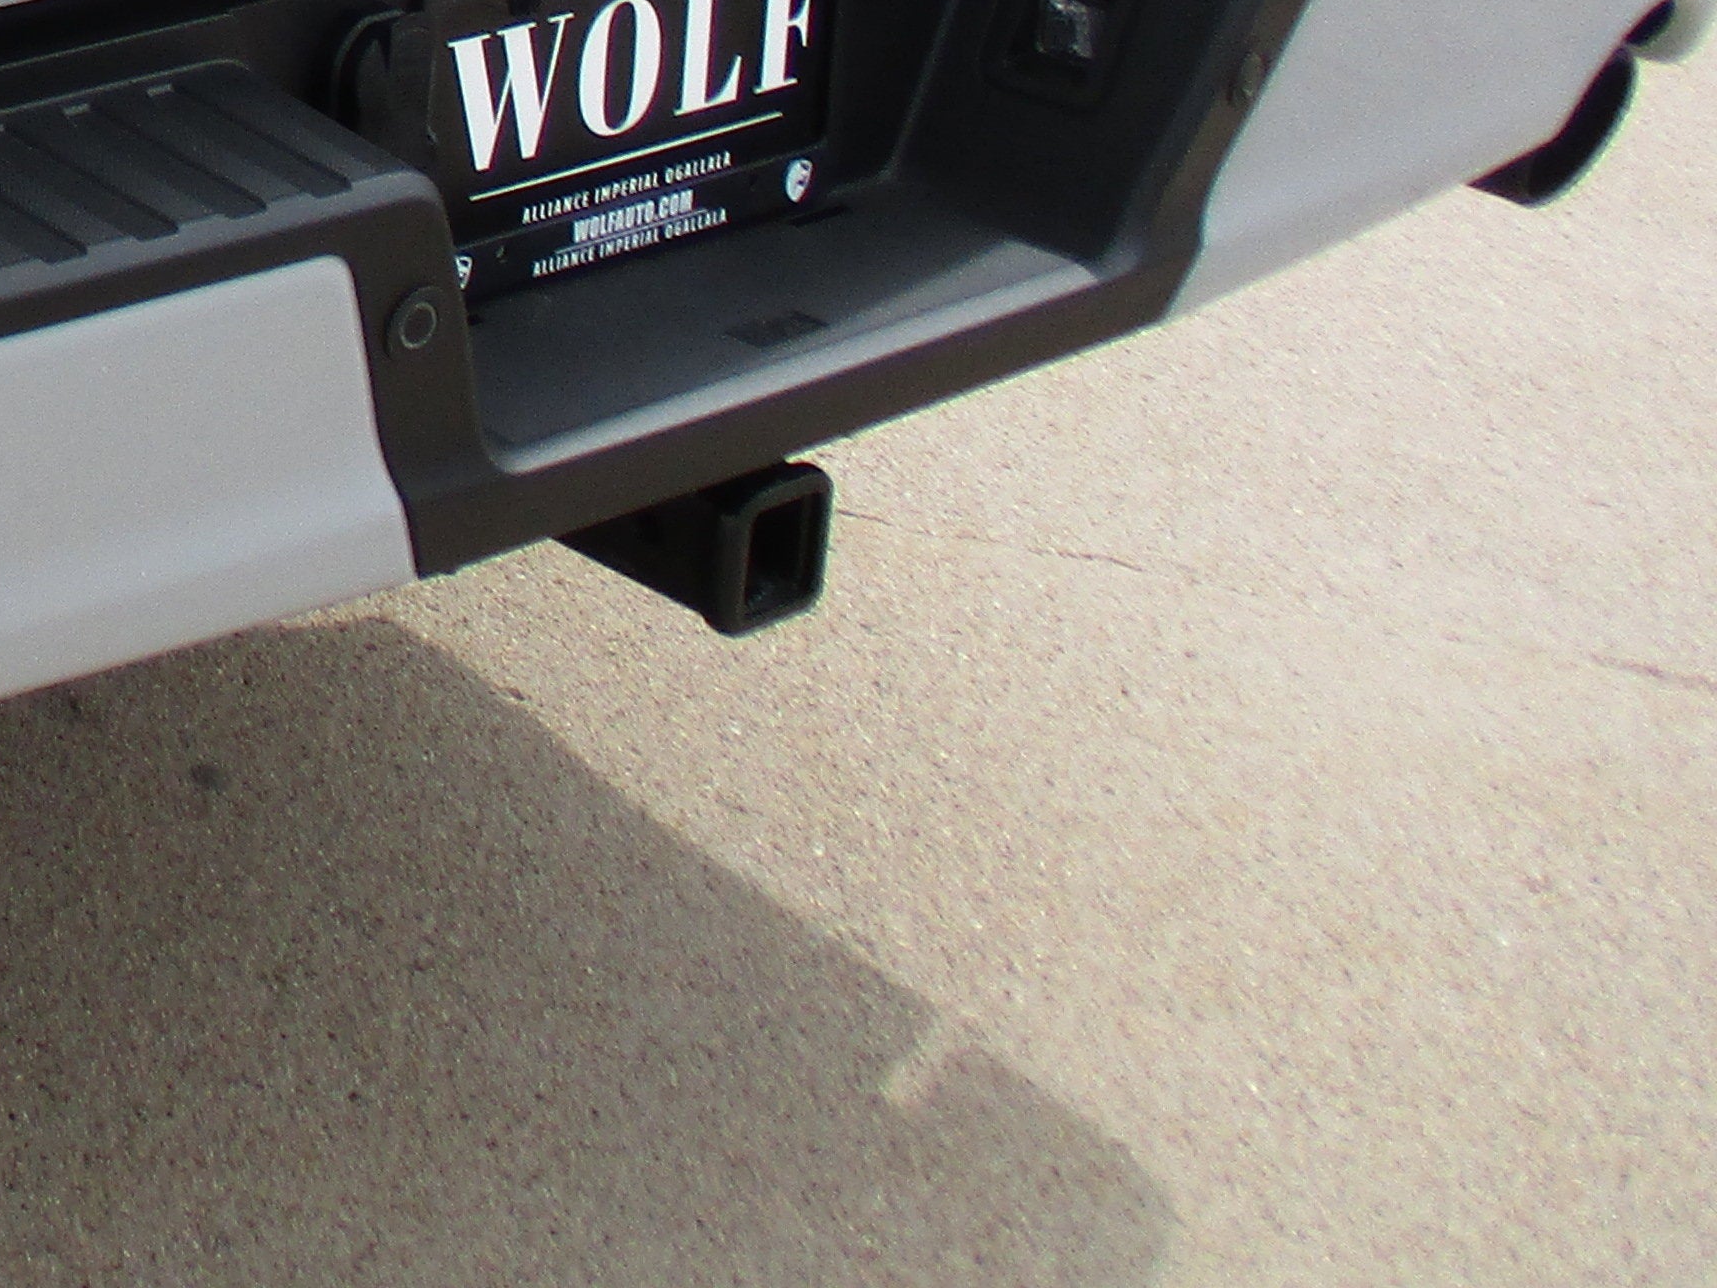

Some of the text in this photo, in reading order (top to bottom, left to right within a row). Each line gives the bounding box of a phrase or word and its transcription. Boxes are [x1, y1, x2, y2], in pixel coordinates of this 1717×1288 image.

[521, 149, 733, 225] ALLIANCE IMPERIAL OGALLALA
[572, 188, 695, 245] WOLFAUTO.COM
[532, 206, 729, 278] ALLIANCE IMPERIAL OGALLALA
